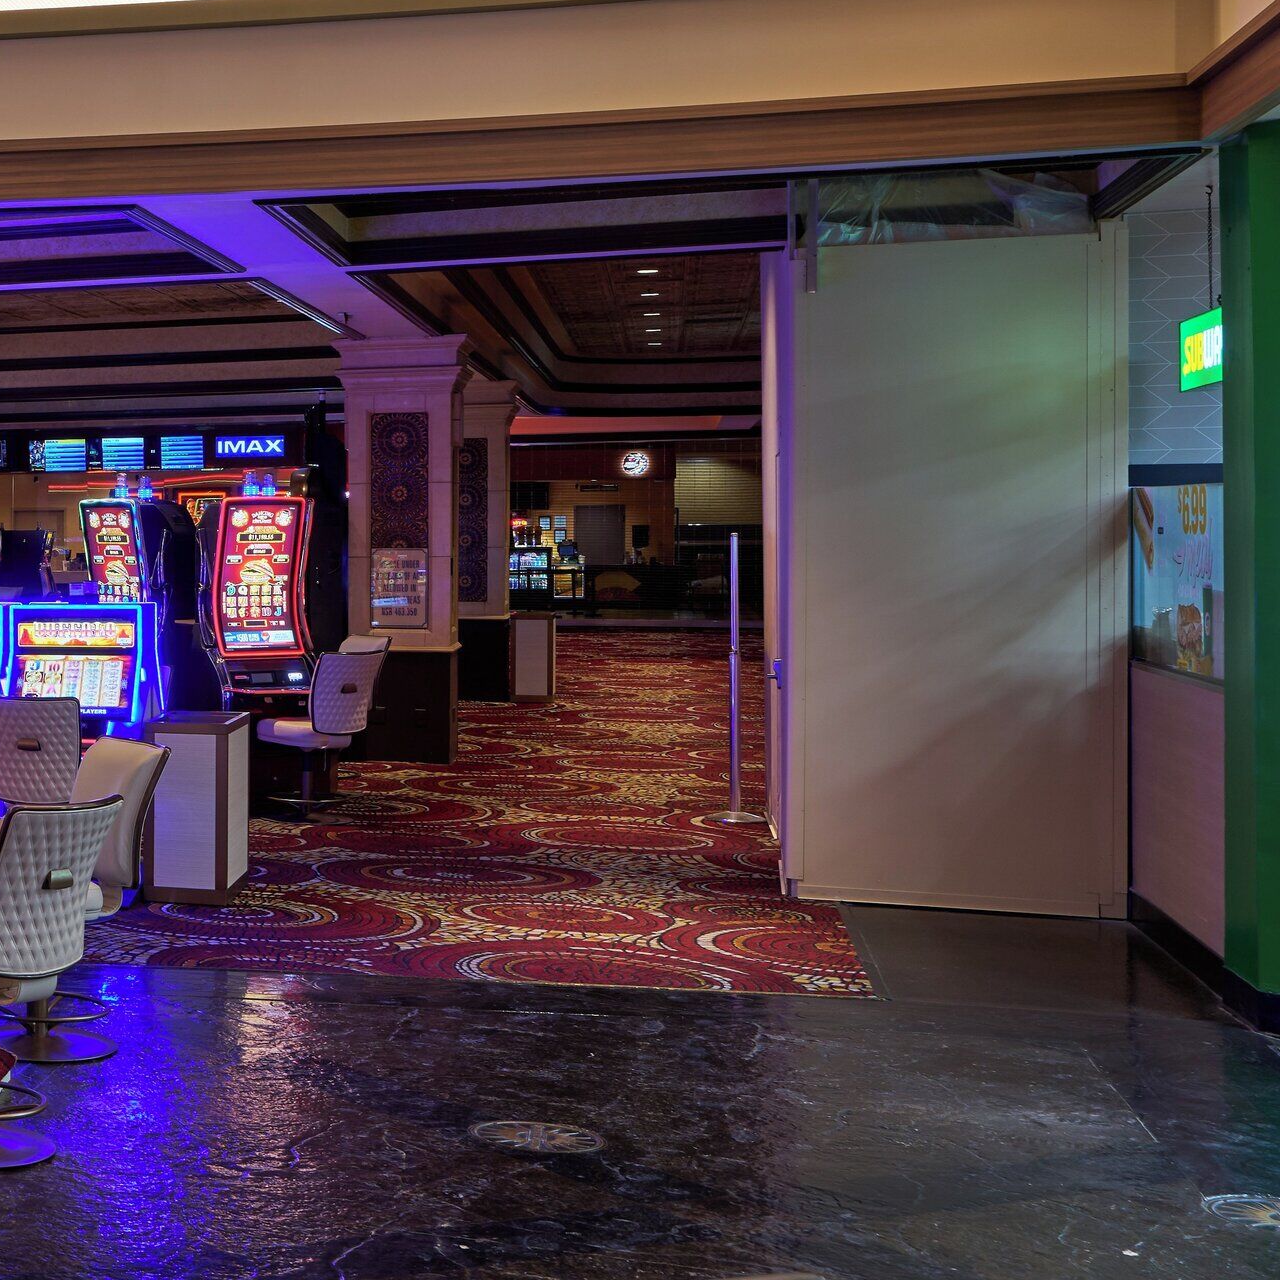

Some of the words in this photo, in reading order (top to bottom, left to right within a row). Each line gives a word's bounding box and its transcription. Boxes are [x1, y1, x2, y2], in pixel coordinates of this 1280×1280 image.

[1183, 325, 1222, 376] SUBWA
[217, 439, 282, 454] IMAX
[1177, 484, 1207, 535] $6.99
[402, 560, 420, 568] UNDER
[410, 584, 417, 592] IN
